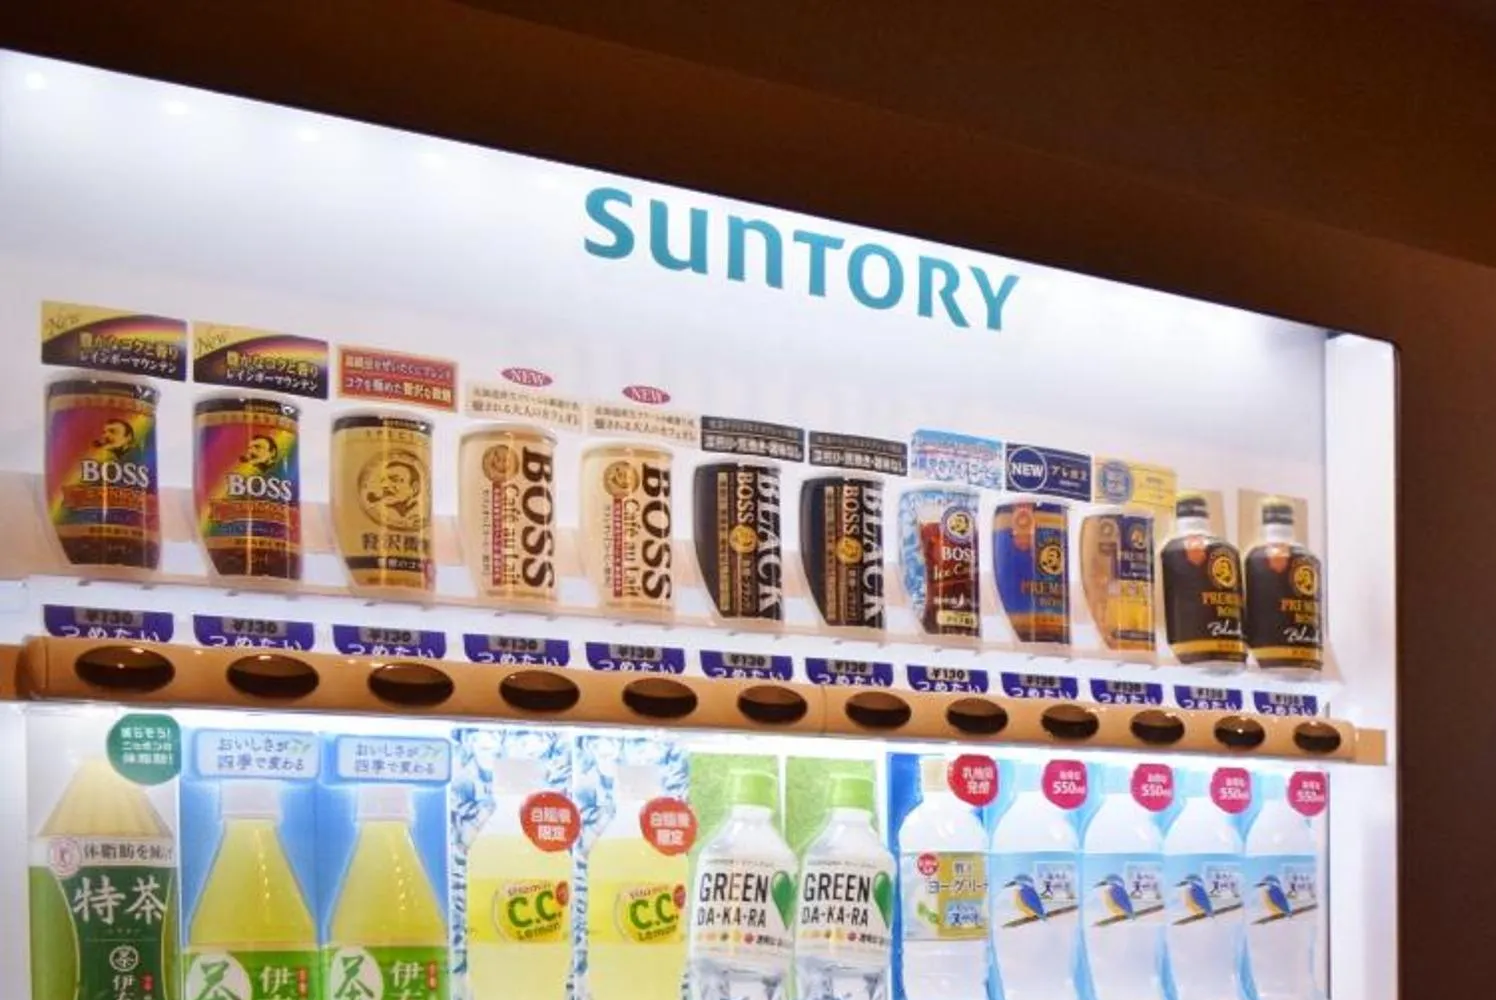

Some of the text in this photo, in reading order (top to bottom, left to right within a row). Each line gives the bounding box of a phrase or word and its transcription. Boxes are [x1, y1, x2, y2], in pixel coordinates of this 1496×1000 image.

[584, 186, 1020, 331] SUNTORY
[511, 368, 545, 387] NEW
[629, 386, 662, 404] NEW
[81, 460, 149, 488] BOSS
[1011, 462, 1044, 479] NEW
[228, 474, 292, 501] BOSS
[737, 471, 754, 524] BOSS
[521, 446, 554, 590] BOSS
[843, 484, 860, 537] BOSS
[642, 463, 673, 602] BOSS
[757, 467, 783, 616] BLACK
[862, 481, 885, 627] BLACK
[60, 625, 160, 643] つめたい
[209, 635, 302, 650] つめたい
[348, 643, 434, 660] つめたい
[477, 651, 568, 667] つめたい
[600, 659, 676, 674] つめたい
[712, 667, 784, 681] つめたい
[817, 673, 885, 687] つめたい
[916, 680, 988, 693] つめたい
[1010, 687, 1073, 700] つめたい
[1100, 693, 1157, 706] つめたい
[1183, 699, 1238, 711] つめたい
[217, 754, 305, 771] 四季で変わる
[699, 872, 768, 903] GREEN
[804, 872, 870, 903] GREEN
[73, 875, 168, 925] 特茶
